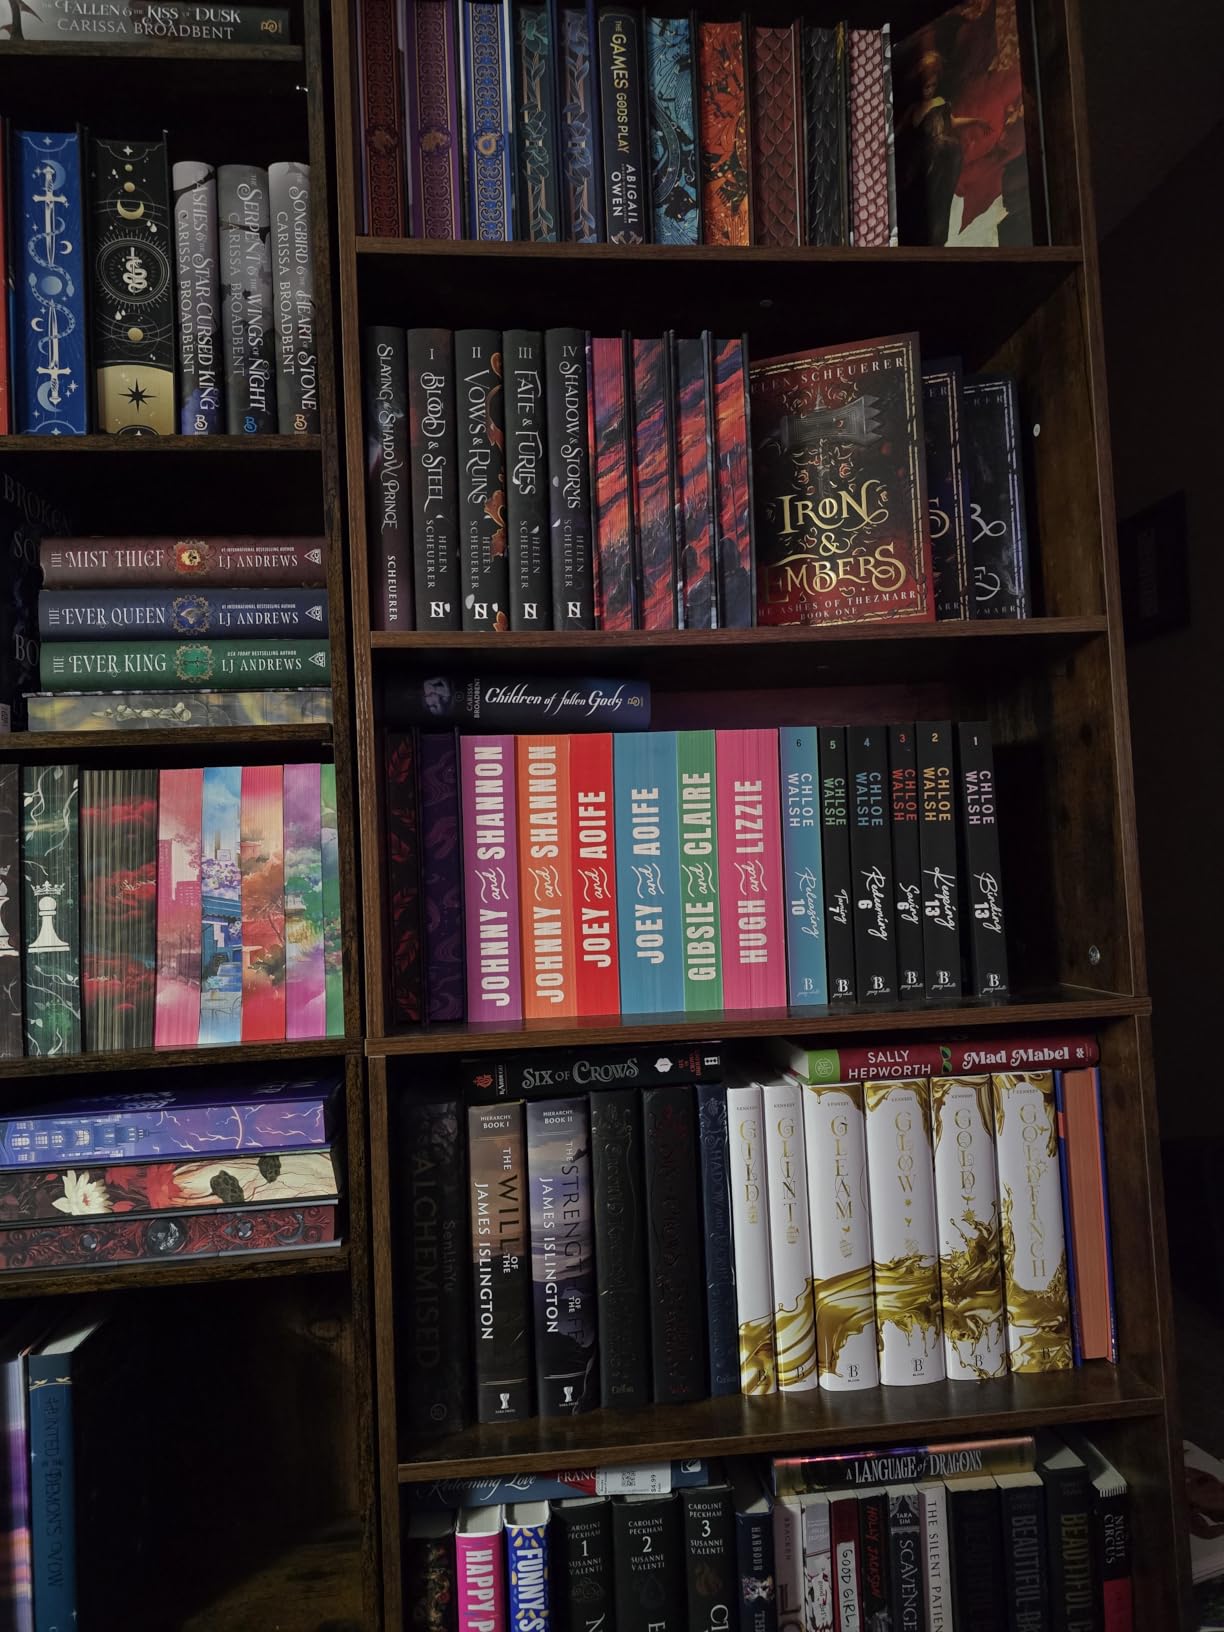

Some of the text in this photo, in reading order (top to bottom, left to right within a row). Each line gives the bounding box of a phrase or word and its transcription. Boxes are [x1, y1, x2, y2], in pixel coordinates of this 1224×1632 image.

[57, 18, 235, 40] CARISSA BROADBENT
[195, 7, 241, 23] DUSK
[610, 33, 629, 89] GAMES
[616, 92, 628, 123] GODS
[617, 125, 630, 154] PLAY
[611, 171, 623, 216] OWEN
[626, 163, 638, 223] ABIGAIL
[178, 210, 194, 374] CARISSA BROADBENT
[229, 212, 245, 376] CARISSA BROADBENT
[276, 212, 295, 375] CARISSA BROADBENT
[289, 186, 317, 411] SONGBIRD STONE
[247, 294, 270, 413] WINGS NIGHT
[377, 344, 394, 400] SLAYING
[472, 347, 481, 359] II
[801, 357, 905, 384] SCHEUERER
[420, 372, 447, 512] BLOOD & STEEL
[464, 369, 491, 504] VOWS & RUINS
[513, 370, 543, 495] FATE & FURIES
[559, 361, 584, 508] SHADOW STORMS
[776, 479, 889, 535] IRON
[65, 549, 166, 568] MIST THIEF
[219, 555, 298, 569] LJ ANDREWS
[426, 520, 436, 588] SCHEUERER
[439, 536, 447, 573] HELEN
[470, 520, 480, 589] SCHEUERER
[482, 537, 491, 573] HELEN
[520, 520, 529, 589] SCHEUERER
[532, 537, 541, 574] HELEN
[564, 520, 573, 588] SCHEUERER
[576, 536, 584, 573] HELEN
[766, 542, 907, 604] EMBERS
[387, 555, 398, 621] SCHEUERER
[825, 590, 917, 608] OF THEZMARR
[835, 608, 858, 616] ONE
[61, 607, 166, 627] EVER QUEEN
[219, 612, 299, 626] LJ ANDREWS
[68, 653, 167, 677] EVER KING
[222, 658, 302, 673] LJ ANDREWS
[473, 677, 481, 719] BROADBENT
[485, 683, 542, 704] Children
[829, 740, 836, 749] 5
[863, 737, 870, 747] 4
[899, 734, 906, 743] 3
[932, 733, 938, 742] 2
[973, 736, 978, 746] 1
[788, 773, 800, 827] WALSH
[801, 773, 814, 827] CHLOE
[824, 777, 836, 825] WALSH
[834, 778, 847, 826] CHLOE
[855, 772, 869, 826] WALSH
[869, 772, 883, 826] CHLOE
[892, 769, 904, 821] WALSH
[904, 769, 917, 821] CHLOE
[923, 767, 936, 821] WALSH
[937, 767, 951, 821] CHLOE
[965, 770, 980, 824] WALSH
[979, 770, 994, 824] CHLOE
[474, 746, 511, 1006] JOHNNY SHANNON
[528, 746, 565, 1004] JOHNNY SHANNON
[578, 791, 611, 968] JOEY AOIFE
[631, 787, 665, 964] JOEY AOIFE
[682, 772, 717, 981] GIBSIE CLAIRE
[734, 780, 768, 964] HUGH LIZZIE
[791, 899, 805, 915] 10
[857, 899, 872, 909] 6
[896, 901, 909, 910] 6
[923, 866, 956, 930] Keeping
[925, 899, 940, 916] 13
[973, 872, 1002, 933] Binding
[974, 902, 990, 919] 13
[521, 1057, 640, 1088] SIX OF CROWS
[849, 1064, 931, 1079] HEPWORTH
[868, 1050, 910, 1064] SALLY
[962, 1046, 1070, 1069] Mad Mabel
[483, 1121, 504, 1129] BOOK
[544, 1116, 566, 1124] BOOK
[566, 1141, 574, 1161] THE
[740, 1119, 760, 1202] GILD
[777, 1118, 798, 1222] GLINT
[831, 1115, 855, 1219] GLEAM
[894, 1111, 917, 1193] GLOW
[954, 1108, 976, 1190] GOLD
[498, 1147, 520, 1250] THE WILL
[1019, 1103, 1047, 1278] GOLDFINCH
[474, 1183, 494, 1340] JAMES ISLINGTON
[502, 1253, 511, 1274] THE
[511, 1256, 518, 1269] OF
[539, 1178, 559, 1333] JAMES ISLINGTON
[568, 1296, 576, 1313] THE
[575, 1298, 582, 1309] OF
[505, 1471, 537, 1490] Love
[854, 1449, 983, 1484] LANGUAGE DRAGONS
[628, 1518, 663, 1528] CAROLINE
[629, 1526, 663, 1535] PECKHAM
[688, 1502, 722, 1510] CAROLINE
[689, 1510, 722, 1518] PECKHAM
[701, 1519, 711, 1537] 3
[690, 1538, 723, 1547] SUSANNE
[927, 1501, 941, 1580] THE SILENT
[1011, 1514, 1041, 1607] BEAUTIFUL
[466, 1549, 495, 1611] HAPPY
[517, 1548, 545, 1609] FUNNY
[581, 1540, 589, 1607] 1
[631, 1562, 665, 1571] VALENTI
[631, 1563, 664, 1604] SUSANNE
[642, 1536, 652, 1602] 2
[690, 1546, 724, 1605] VALENTI
[842, 1549, 855, 1584] GOOD
[867, 1546, 881, 1598] JACKSON
[899, 1539, 919, 1631] SCAVENGE
